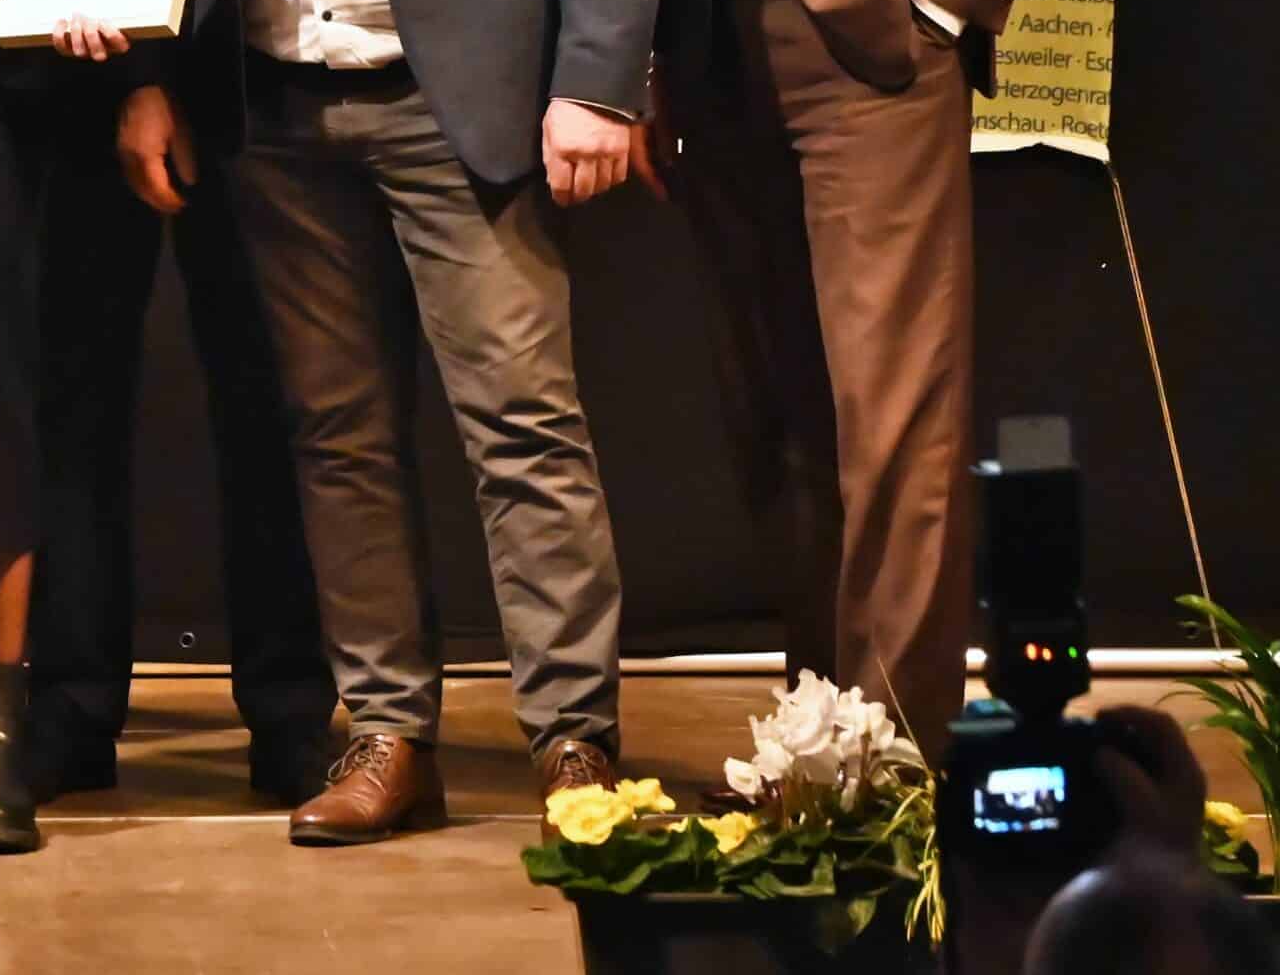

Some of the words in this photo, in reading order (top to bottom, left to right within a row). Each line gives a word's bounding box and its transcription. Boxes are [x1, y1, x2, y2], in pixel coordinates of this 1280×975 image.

[1019, 13, 1093, 37] Aachen
[996, 78, 1111, 106] Herzogenra
[1061, 115, 1109, 139] Roet
